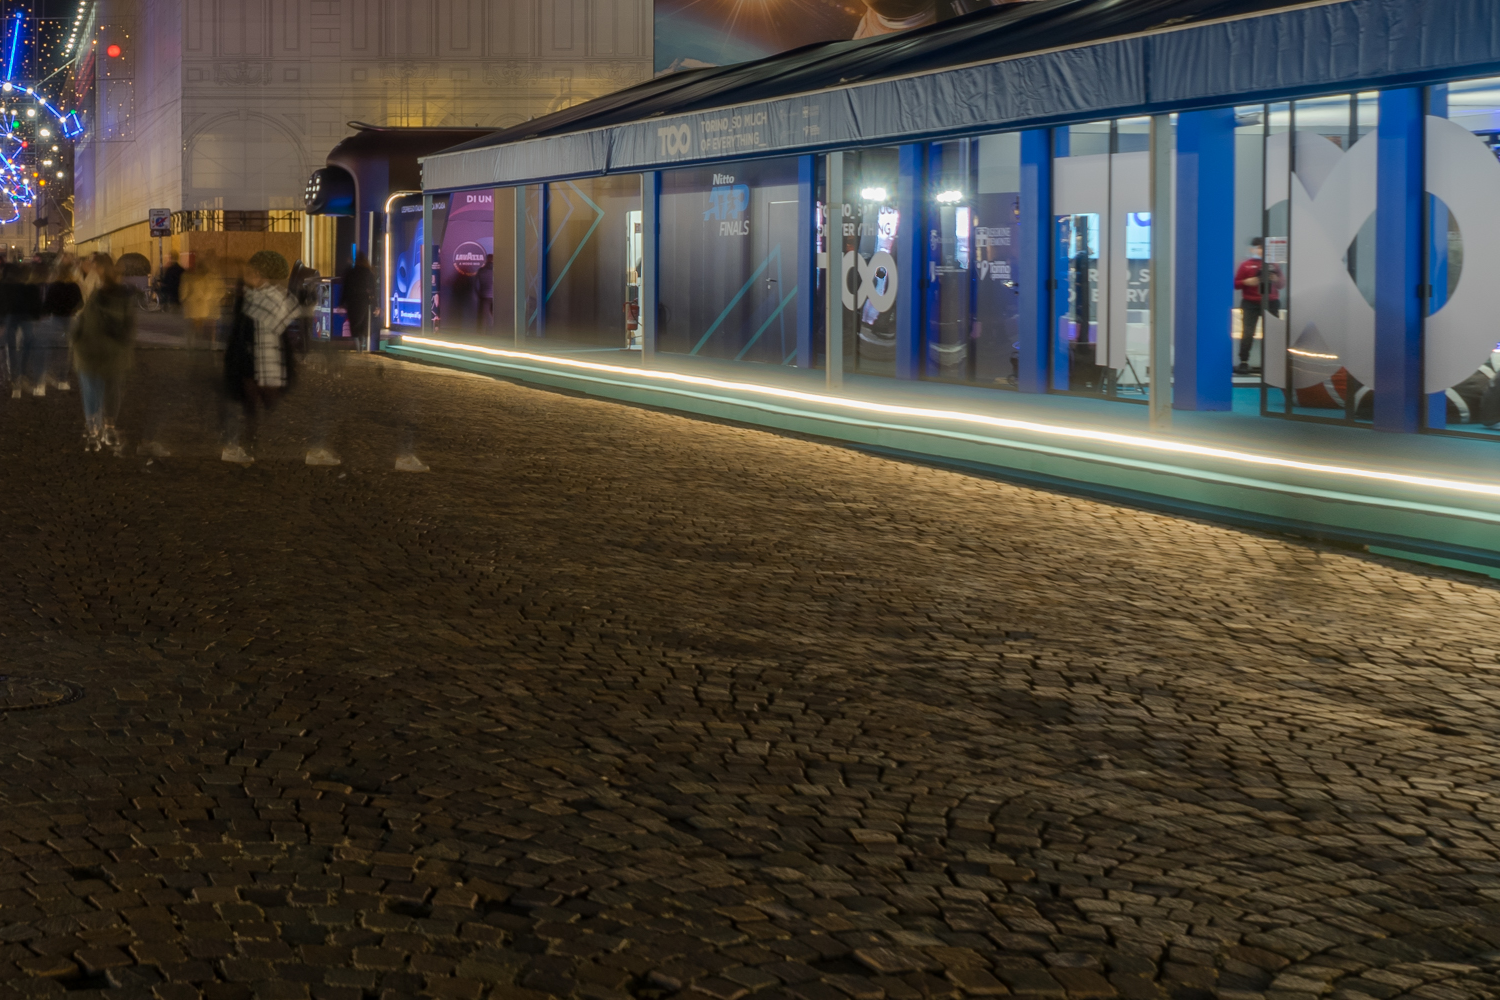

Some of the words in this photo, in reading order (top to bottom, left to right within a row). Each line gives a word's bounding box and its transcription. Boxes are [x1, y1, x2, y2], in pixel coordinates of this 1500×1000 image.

[744, 112, 767, 127] MUCH
[701, 138, 710, 152] OF
[712, 173, 735, 186] Nitto
[466, 195, 476, 203] DI
[478, 195, 492, 203] UN
[719, 220, 750, 237] FINALS
[455, 252, 485, 261] LAVAZZA
